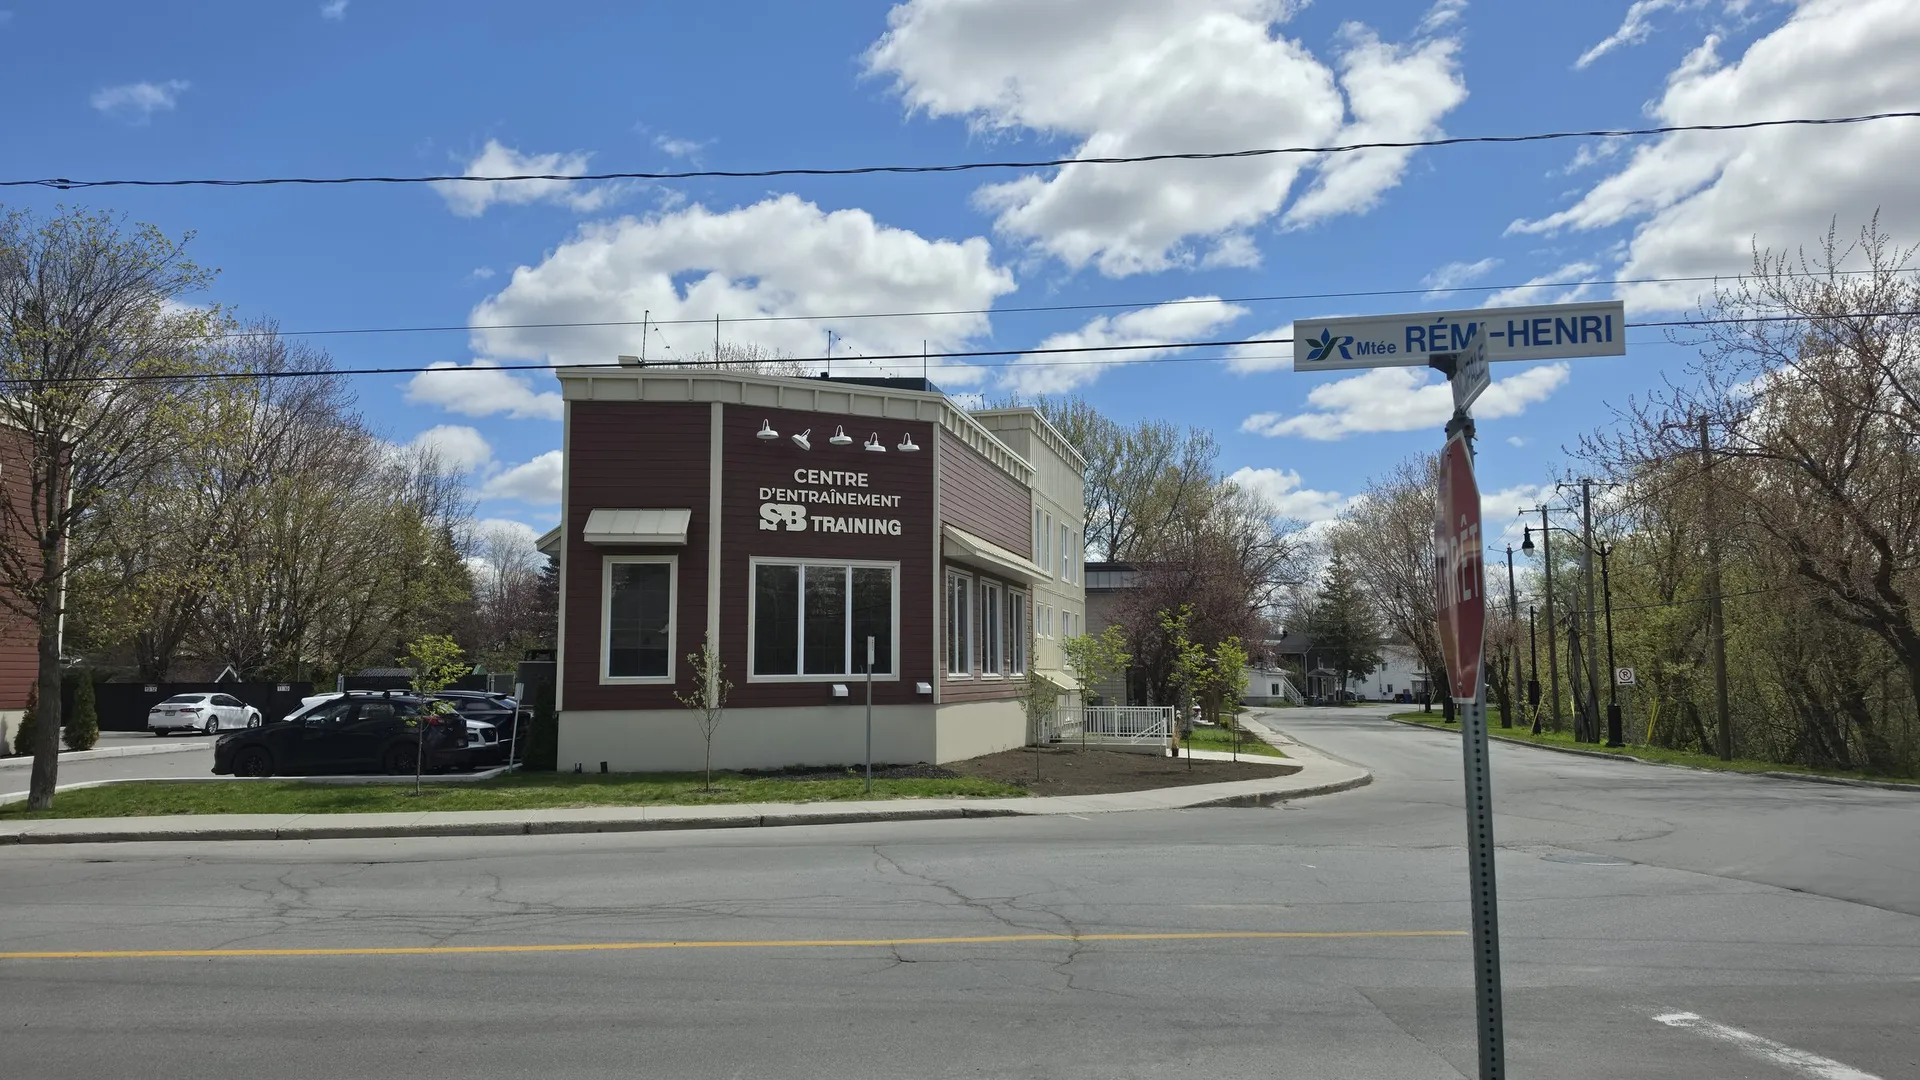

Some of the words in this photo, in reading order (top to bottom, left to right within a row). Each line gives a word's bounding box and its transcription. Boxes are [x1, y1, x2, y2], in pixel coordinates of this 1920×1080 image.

[1356, 340, 1397, 356] Mtée
[1404, 314, 1614, 353] RÉM-HENRI
[793, 468, 869, 488] CENTRE
[759, 487, 902, 508] D'ENTRAÎNEMENT
[810, 515, 902, 536] TRAINING
